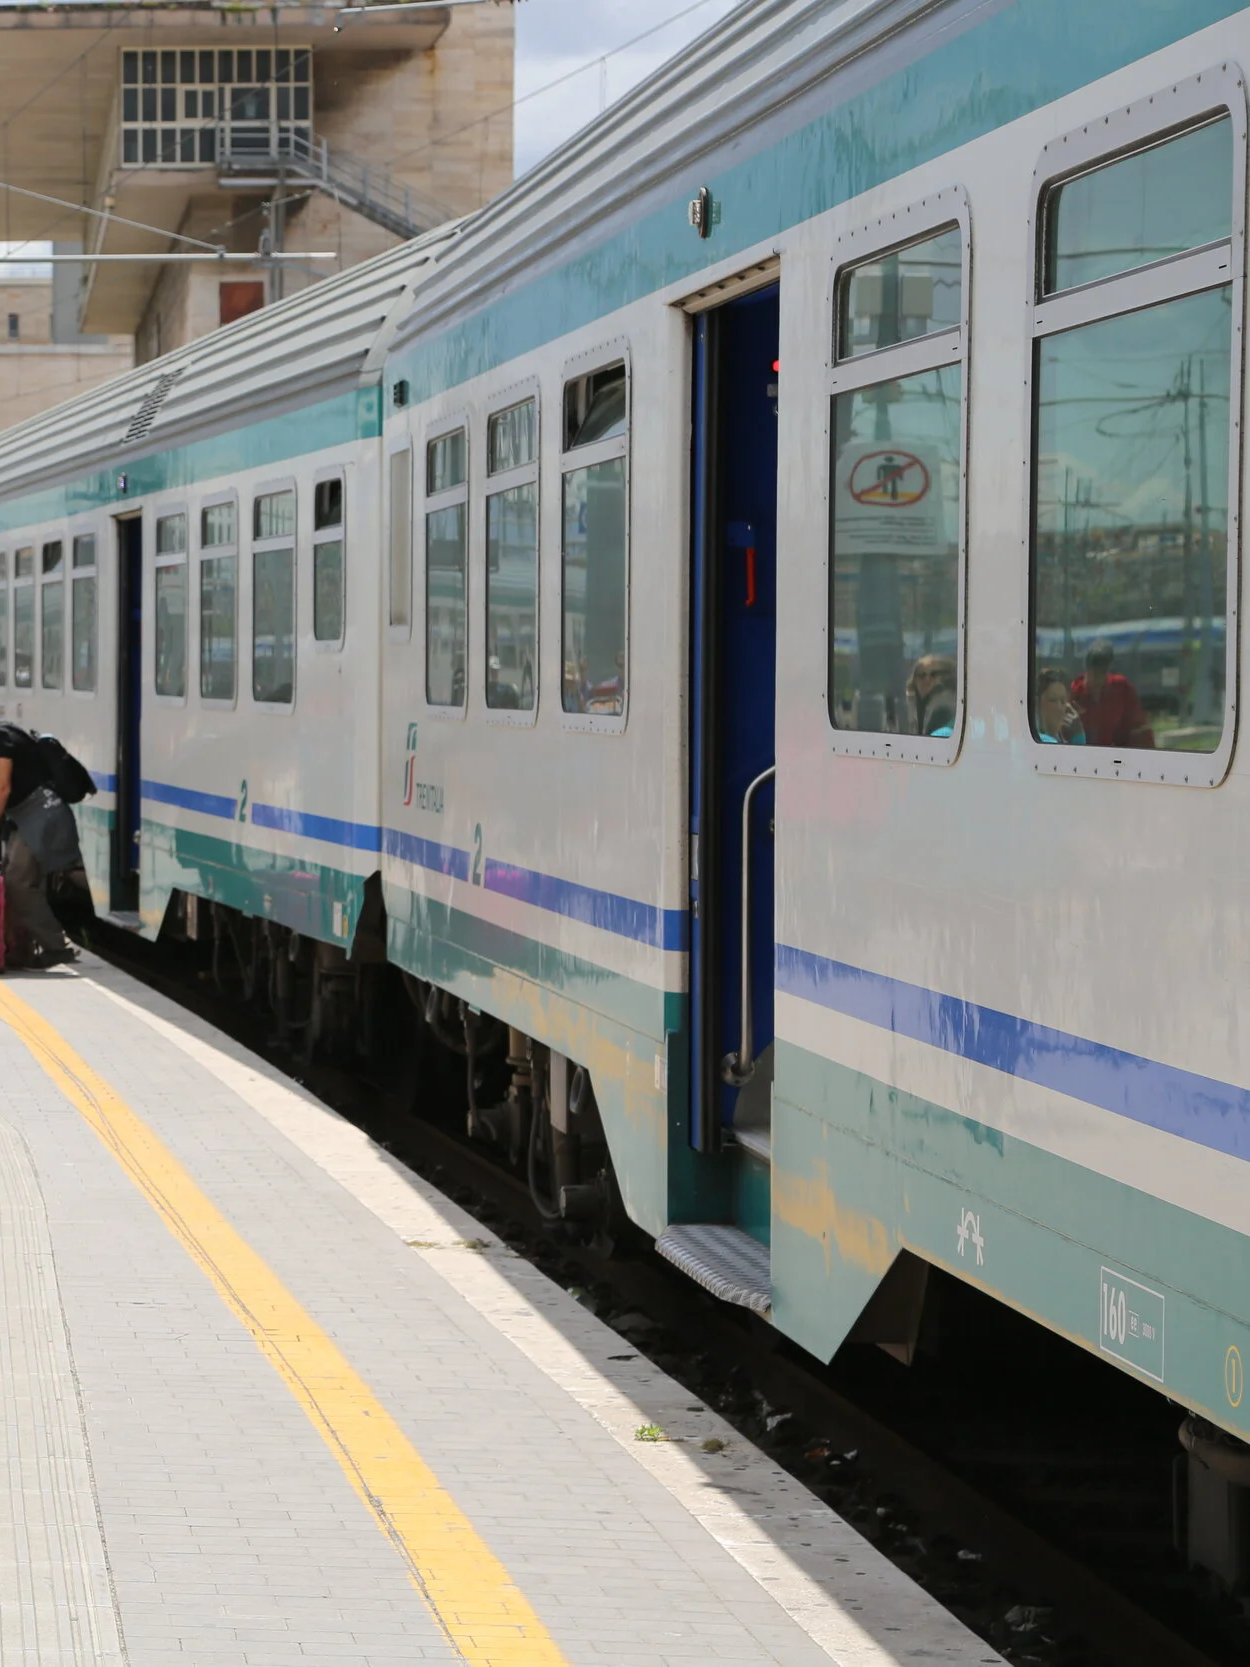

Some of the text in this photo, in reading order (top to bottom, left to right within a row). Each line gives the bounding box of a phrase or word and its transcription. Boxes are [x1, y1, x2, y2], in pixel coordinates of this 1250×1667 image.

[239, 779, 248, 823] 2
[472, 822, 483, 887] 2
[1103, 1283, 1126, 1344] 160
